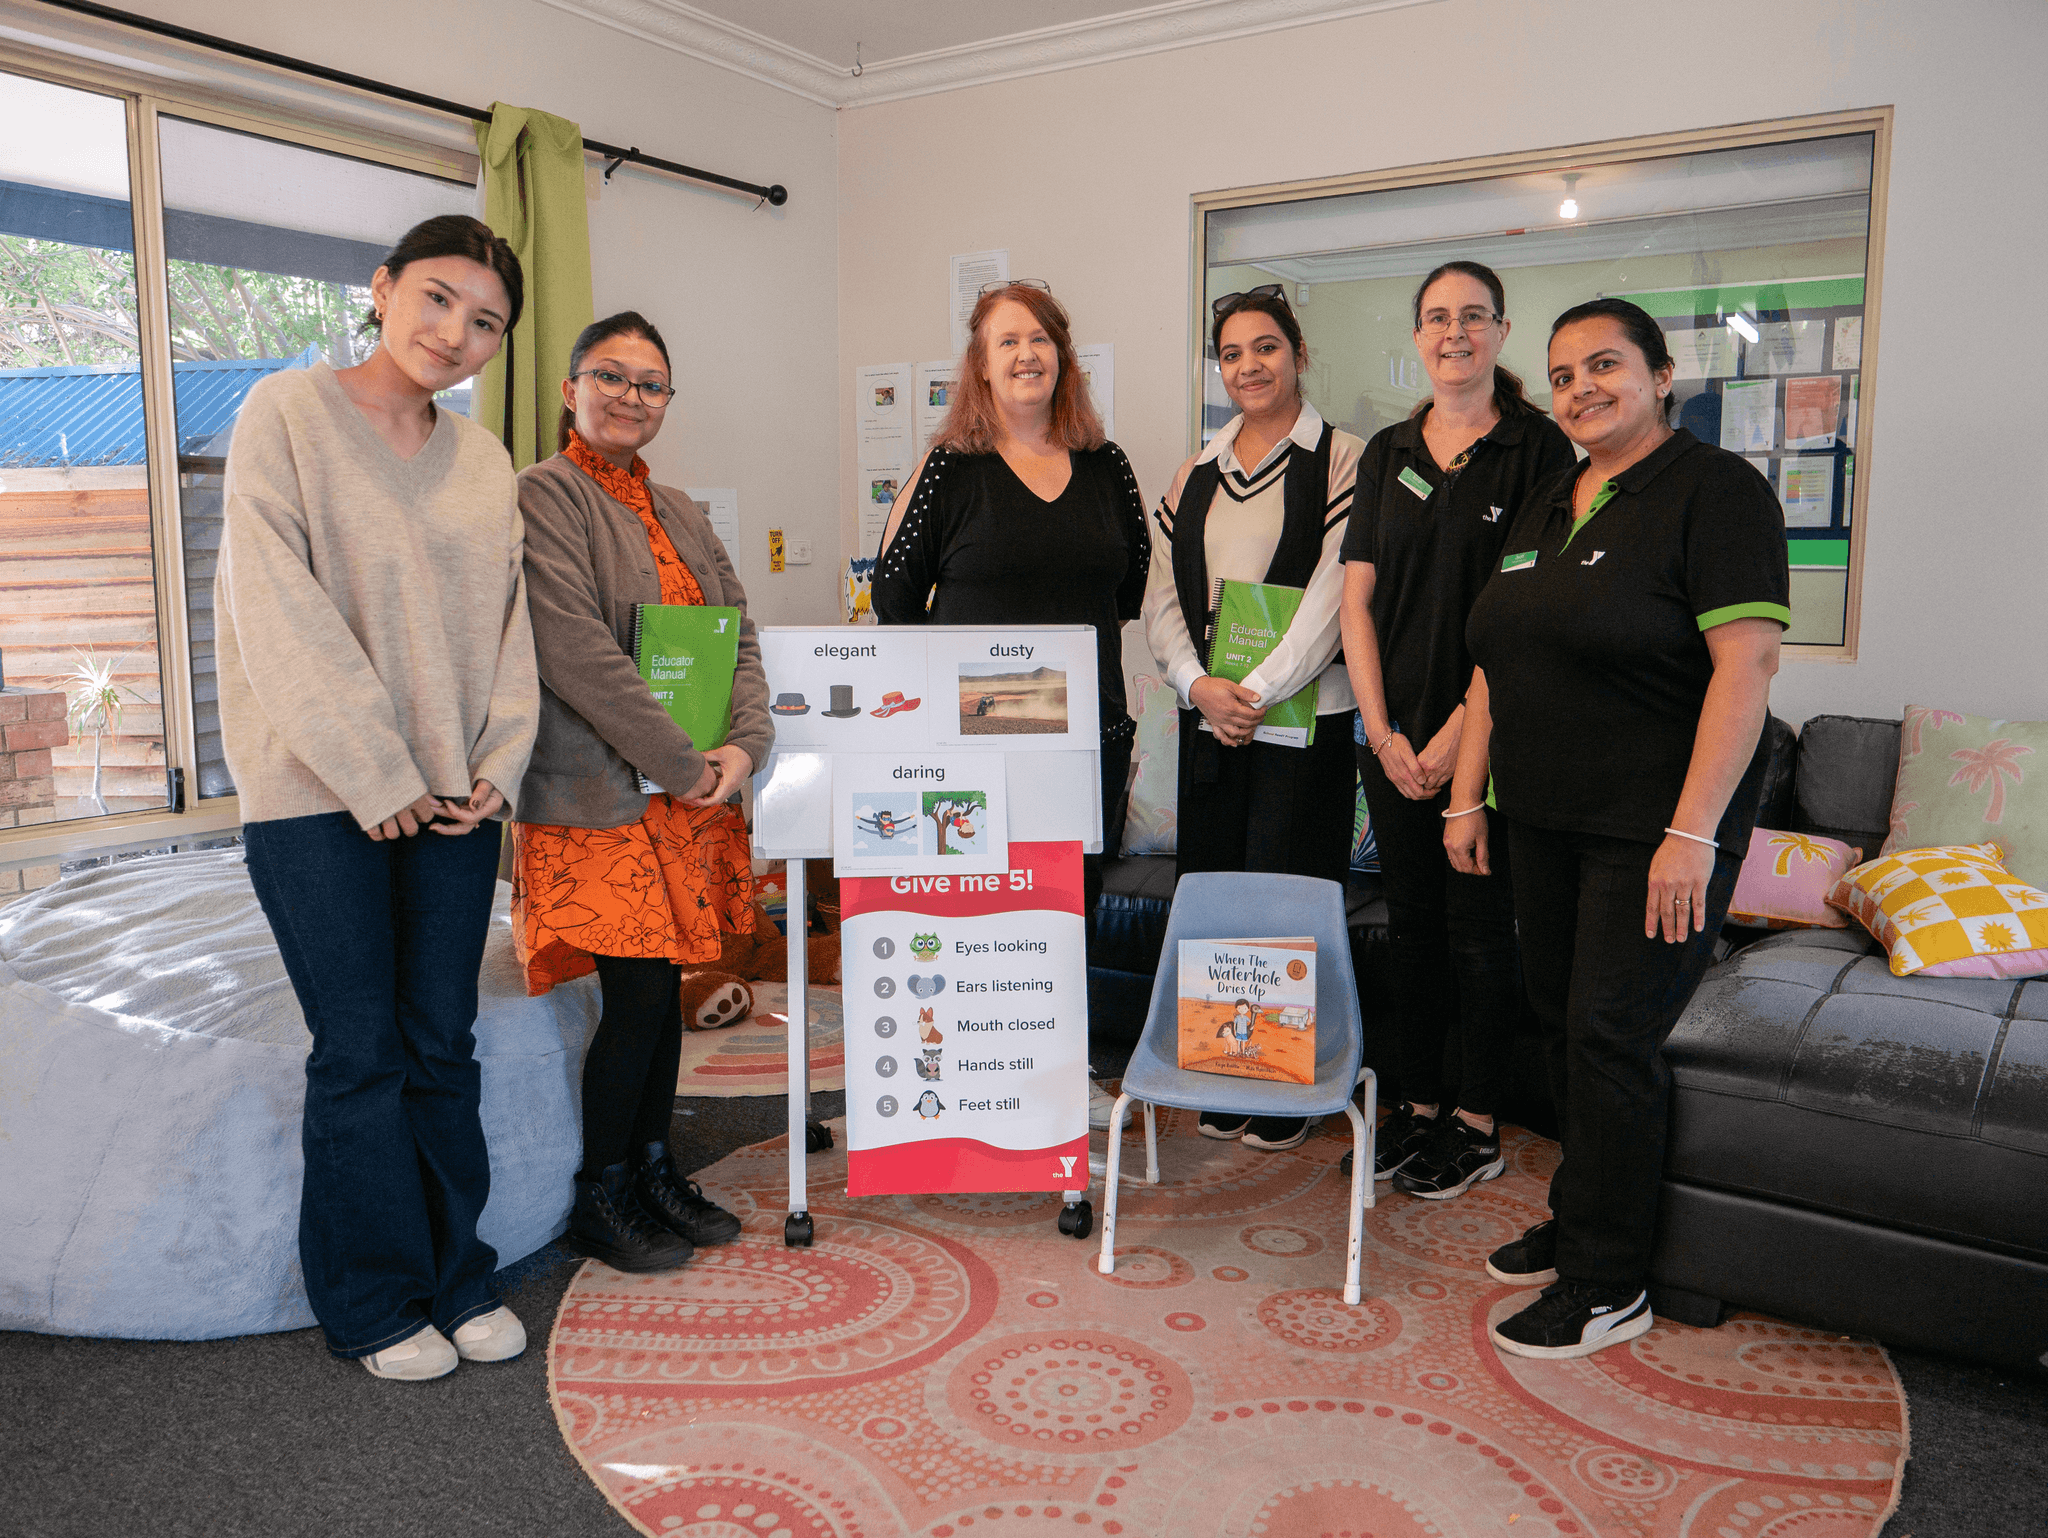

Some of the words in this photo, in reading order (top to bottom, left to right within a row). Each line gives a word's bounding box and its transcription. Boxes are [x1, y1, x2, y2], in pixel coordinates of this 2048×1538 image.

[1230, 623, 1277, 639] Educator
[1228, 634, 1268, 649] Manual
[814, 643, 877, 659] elegant
[989, 643, 1035, 659] dusty
[1226, 652, 1246, 662] UNIT
[1245, 655, 1252, 663] 2
[651, 654, 695, 667] Educator
[650, 668, 687, 680] Manual
[668, 691, 675, 699] 2
[892, 765, 946, 782] daring
[890, 874, 951, 894] Give
[959, 874, 1001, 892] me
[1009, 869, 1033, 891] 5!
[880, 942, 888, 955] 1
[955, 940, 990, 956] Eyes
[994, 938, 1048, 953] looking
[1214, 952, 1245, 966] When
[1249, 954, 1268, 968] The
[1208, 965, 1281, 986] Waterhole
[880, 983, 890, 994] 2
[956, 980, 988, 993] Ears
[992, 977, 1054, 993] listening
[1217, 981, 1246, 995] Dries
[1249, 983, 1266, 1002] Up
[881, 1022, 891, 1034] 3
[957, 1019, 1004, 1032] Mouth
[1008, 1017, 1056, 1031] closed
[882, 1061, 891, 1073] 4
[958, 1059, 1006, 1072] Hands
[1009, 1057, 1034, 1071] still
[883, 1100, 892, 1112] 5
[959, 1099, 993, 1111] Feet
[996, 1097, 1021, 1111] still
[1059, 1156, 1078, 1178] Y
